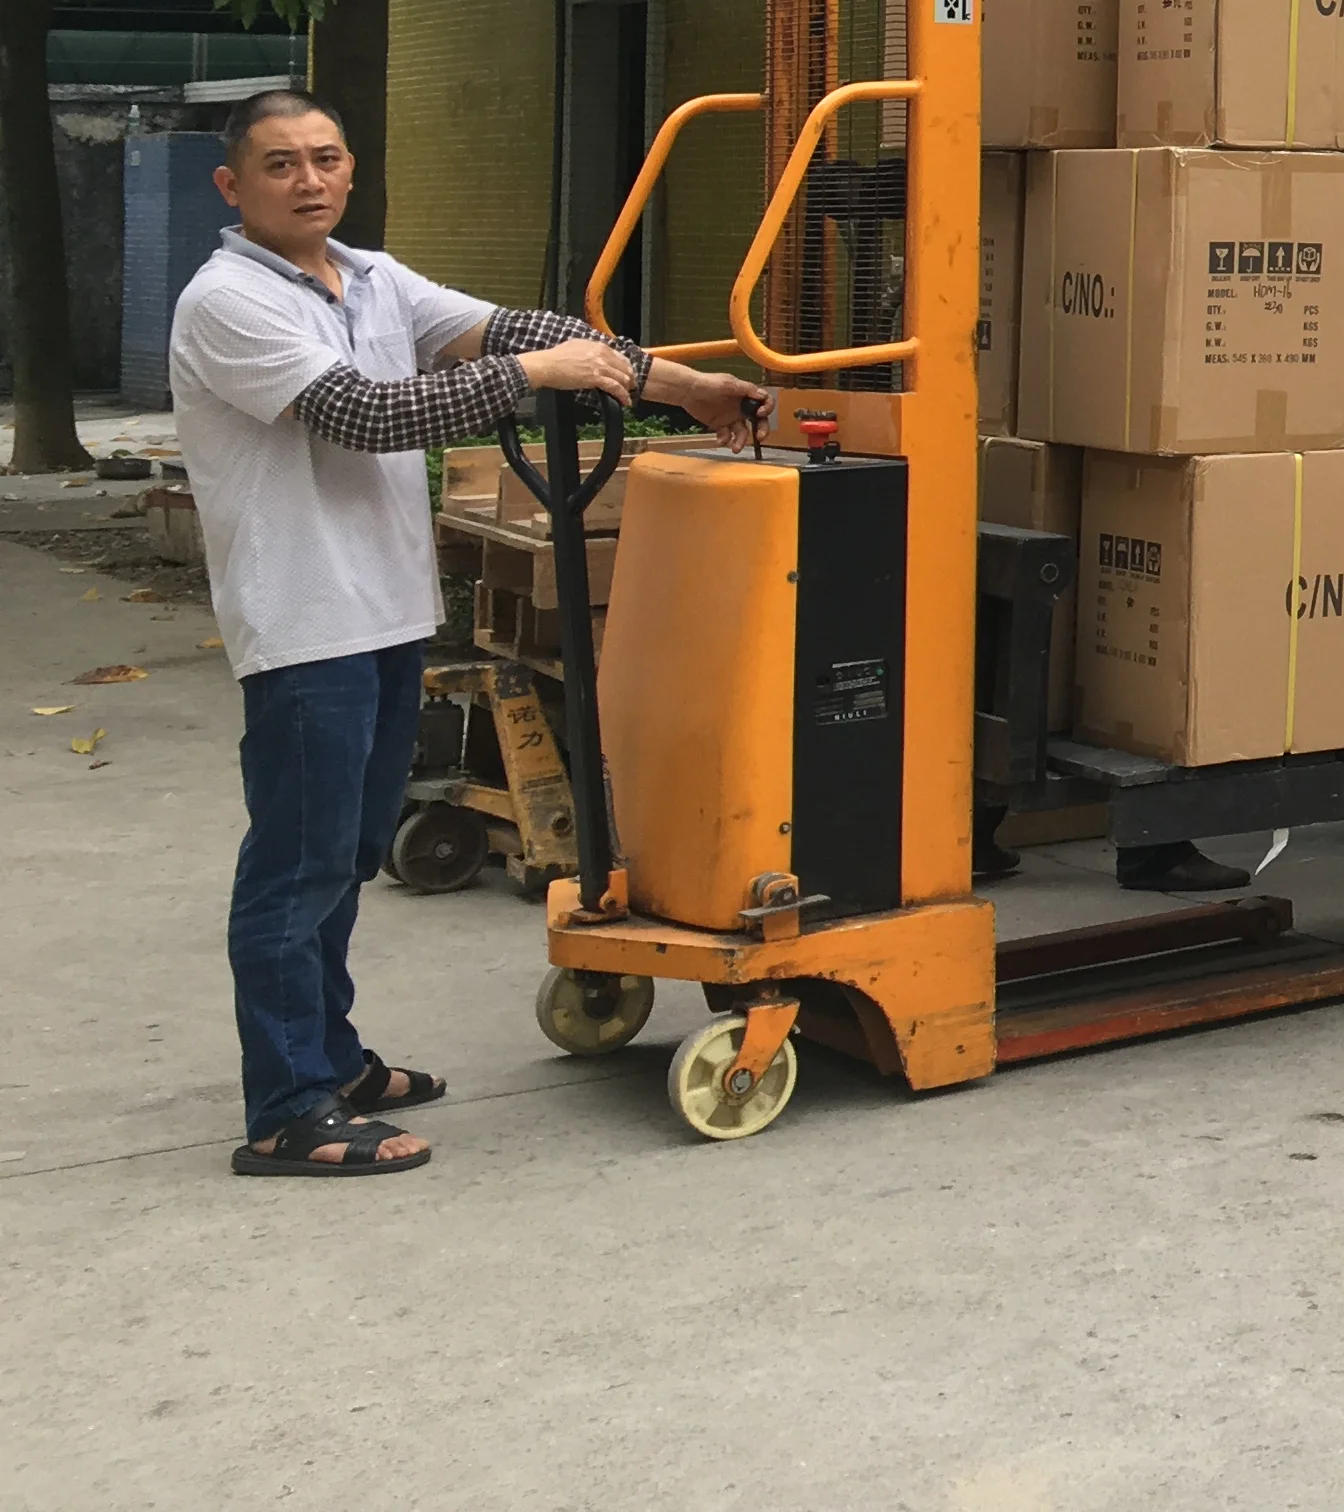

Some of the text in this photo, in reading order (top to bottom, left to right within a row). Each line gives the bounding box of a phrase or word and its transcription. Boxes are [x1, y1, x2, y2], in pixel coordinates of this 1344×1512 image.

[1062, 271, 1114, 318] C/NO.:
[1303, 305, 1320, 315] PCS
[1303, 321, 1318, 331] KGS
[1303, 337, 1318, 348] KGS
[1250, 354, 1256, 363] X
[1276, 353, 1281, 363] X
[1301, 353, 1316, 363] MM
[507, 705, 543, 749] 诺力
